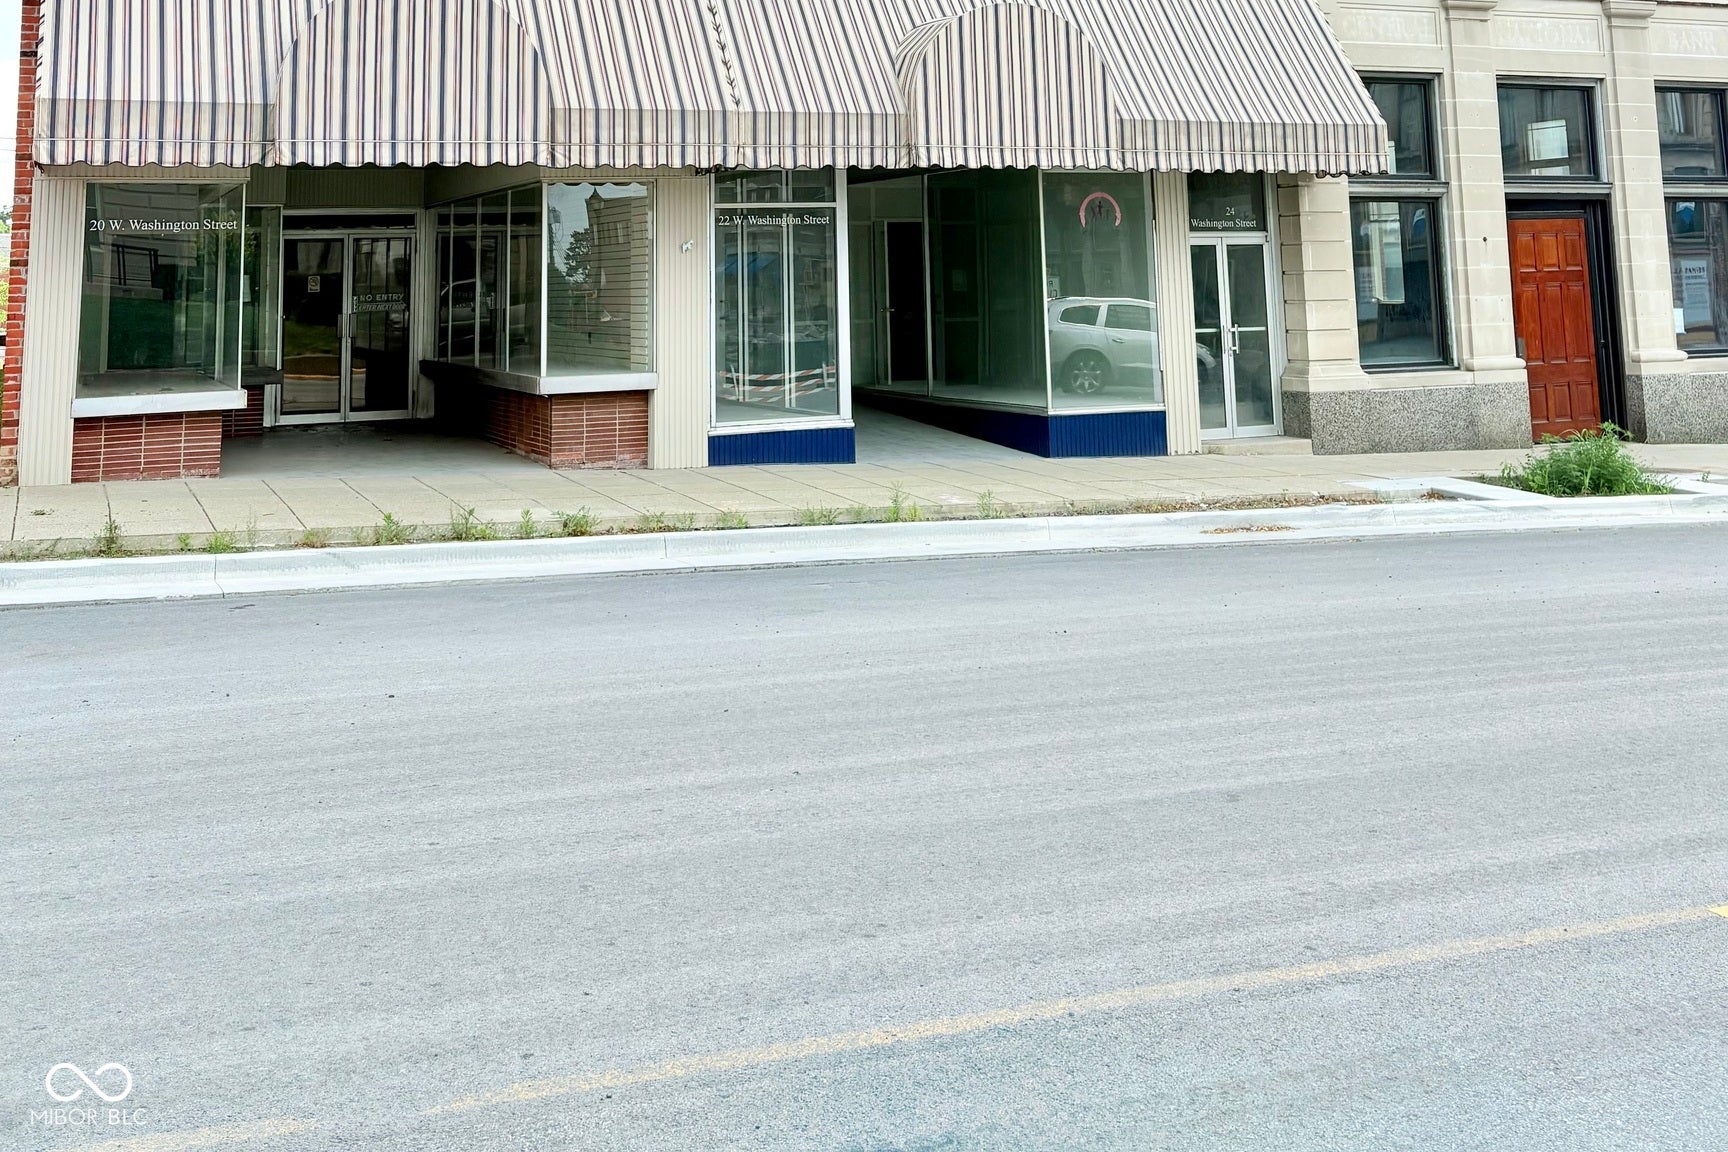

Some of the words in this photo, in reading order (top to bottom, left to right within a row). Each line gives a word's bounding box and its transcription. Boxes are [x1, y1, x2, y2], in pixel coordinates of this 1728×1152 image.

[1225, 207, 1235, 216] 24
[89, 219, 106, 231] 20
[109, 219, 125, 231] W.
[129, 218, 200, 232] Washington
[203, 218, 238, 230] Street
[718, 215, 730, 226] 22
[733, 215, 745, 225] W.
[748, 214, 801, 227] Washington
[803, 214, 830, 225] Street
[1190, 218, 1234, 230] Washington
[1235, 218, 1257, 228] Street
[360, 294, 373, 302] NO
[376, 293, 404, 301] ENTRY
